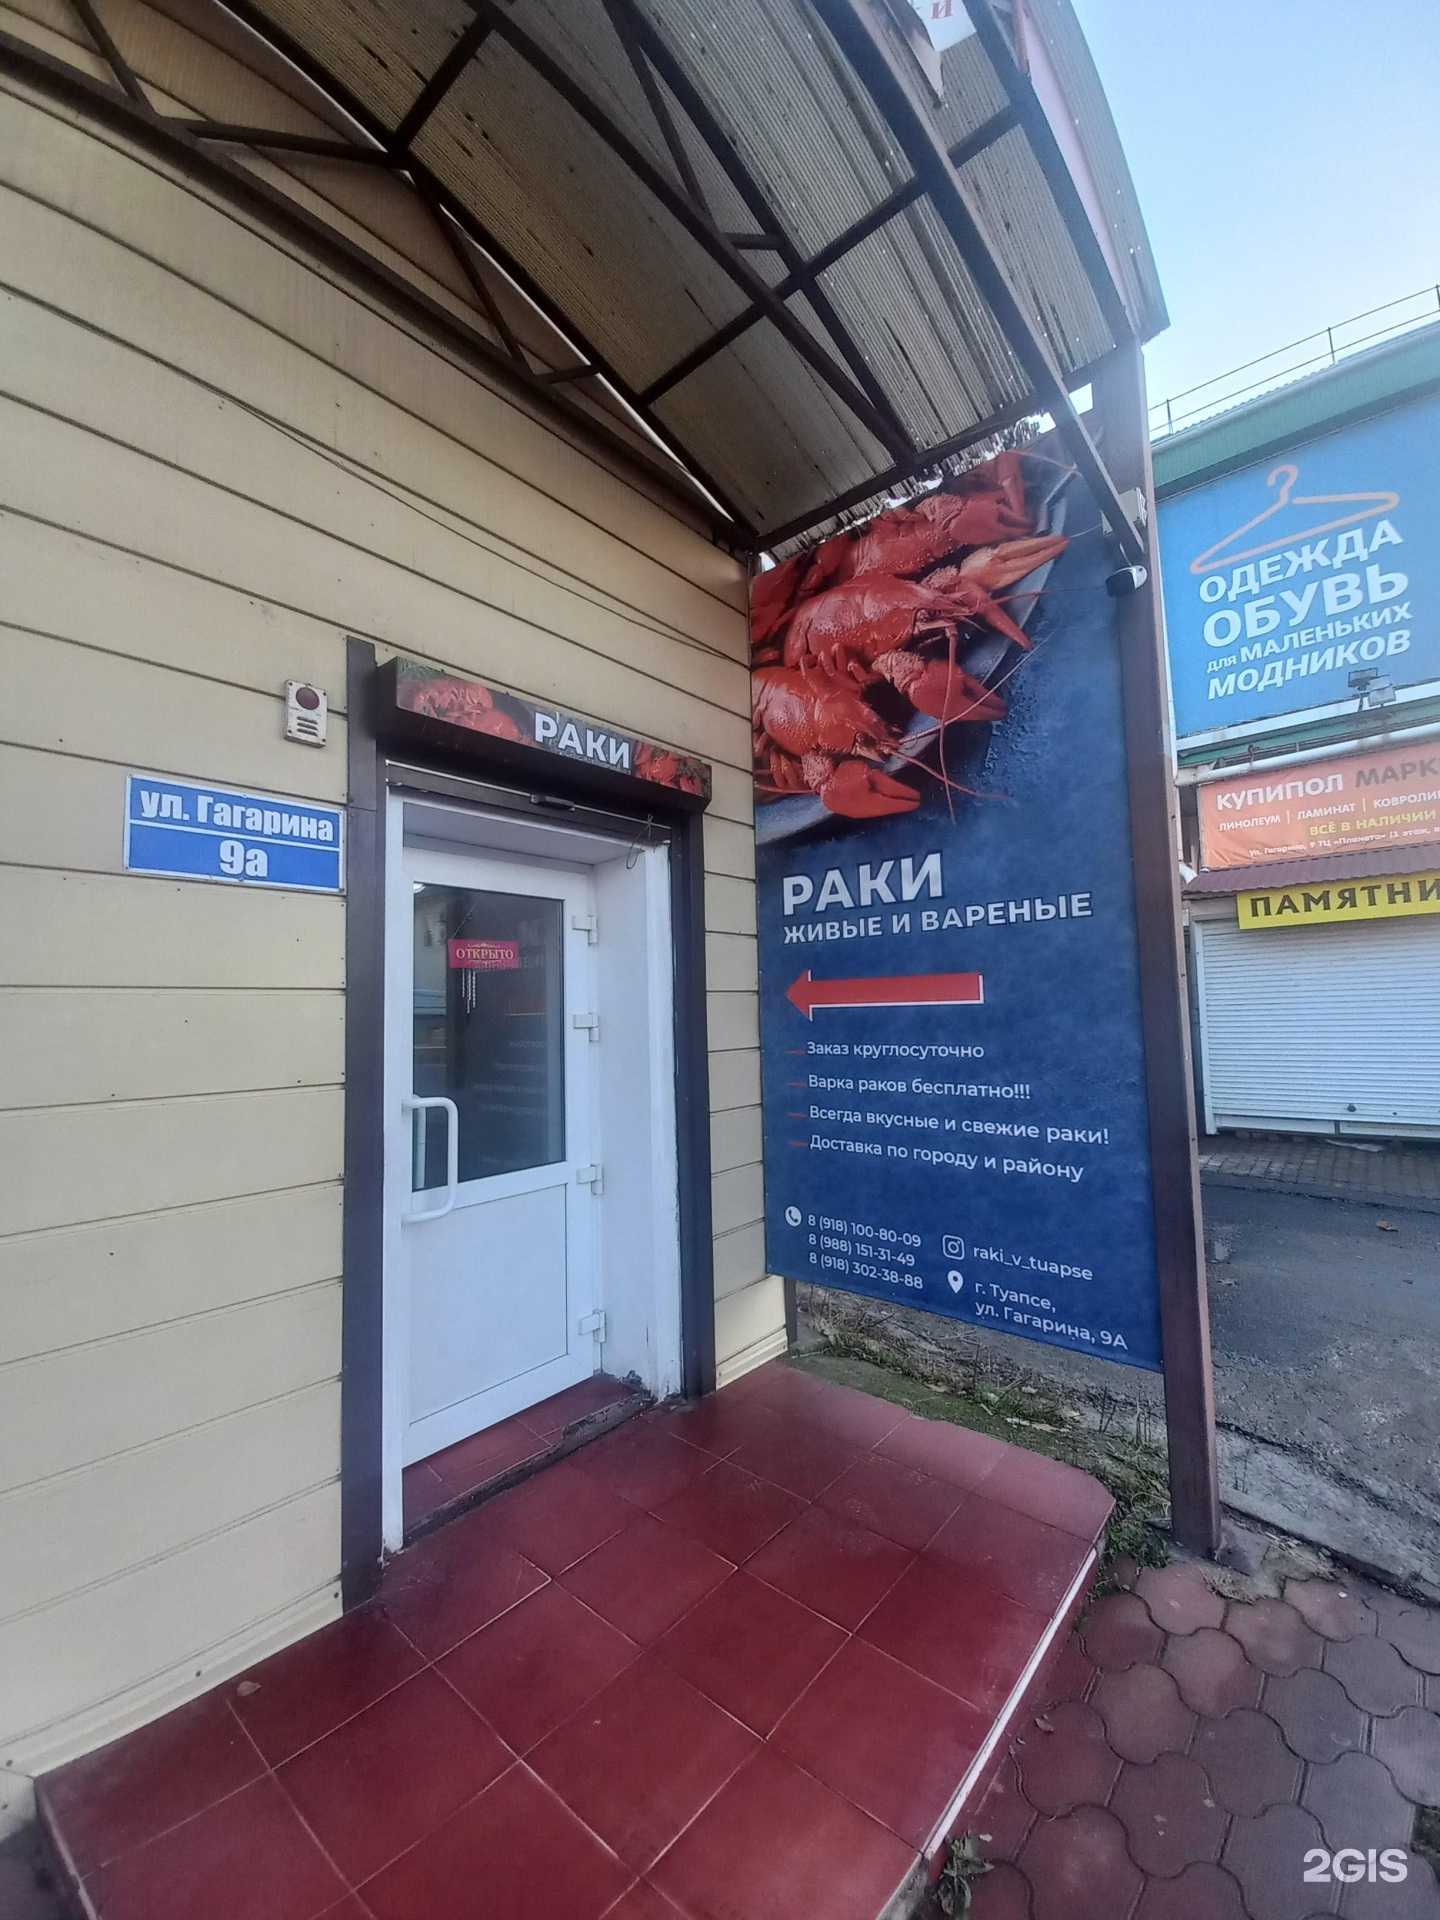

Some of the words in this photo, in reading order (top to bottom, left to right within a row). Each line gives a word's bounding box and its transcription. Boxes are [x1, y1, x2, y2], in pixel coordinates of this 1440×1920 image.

[1199, 519, 1404, 603] ОДЕЖДА
[1203, 563, 1409, 648] ОБУВЬ
[1207, 655, 1237, 674] для
[1239, 602, 1414, 663] МАЛЕНЬКИХ
[1208, 629, 1411, 700] МОДНИКОВ
[534, 711, 630, 769] РАКИ
[1216, 773, 1344, 812] КУПИПОЛ
[140, 788, 190, 821] ул.
[197, 795, 334, 842] Гагарина
[1218, 815, 1281, 832] ЛИНОЛЕУМ
[1297, 803, 1356, 821] ЛАМИНАТ
[1310, 822, 1337, 836] ВСЁ
[1341, 822, 1351, 833] В
[1356, 810, 1436, 830] НАЛИЧИИ
[219, 841, 268, 878] 9а
[782, 853, 944, 915] РАКИ
[783, 916, 882, 945] ЖИВЫЕ
[892, 913, 911, 935] И
[921, 892, 1093, 931] ВАРЕНЫЕ
[456, 948, 514, 960] ОТКРЫТО
[807, 1041, 849, 1055] Заказ
[854, 1043, 985, 1060] круглосуточно
[808, 1074, 854, 1090] Варка
[858, 1079, 907, 1093] раков
[911, 1078, 1031, 1099] бесплатно!!!
[810, 1106, 862, 1123] Всегда
[866, 1112, 939, 1130] вкусные
[944, 1118, 957, 1131] и
[962, 1119, 1040, 1138] свежие
[1046, 1125, 1110, 1145] раки!
[810, 1135, 882, 1155] Доставка
[887, 1146, 908, 1159] по
[913, 1147, 978, 1169] городу
[984, 1156, 997, 1169] и
[1003, 1158, 1084, 1183] району
[807, 1214, 816, 1227] 8
[819, 1215, 848, 1236] (918)
[850, 1222, 921, 1247] 100-80-09
[808, 1233, 817, 1246] 8
[820, 1234, 852, 1255] (988)
[855, 1242, 915, 1267] 151-31-49
[809, 1252, 817, 1265] 8
[820, 1253, 850, 1275] (918)
[852, 1261, 924, 1290] 302-38-88
[973, 1245, 1094, 1281] raki_v_tuapse
[974, 1283, 986, 1296] г.
[989, 1284, 1057, 1314] Туапсе,
[975, 1301, 1000, 1320] ул.
[1003, 1306, 1096, 1344] Гагарина,
[1100, 1329, 1129, 1350] 9А
